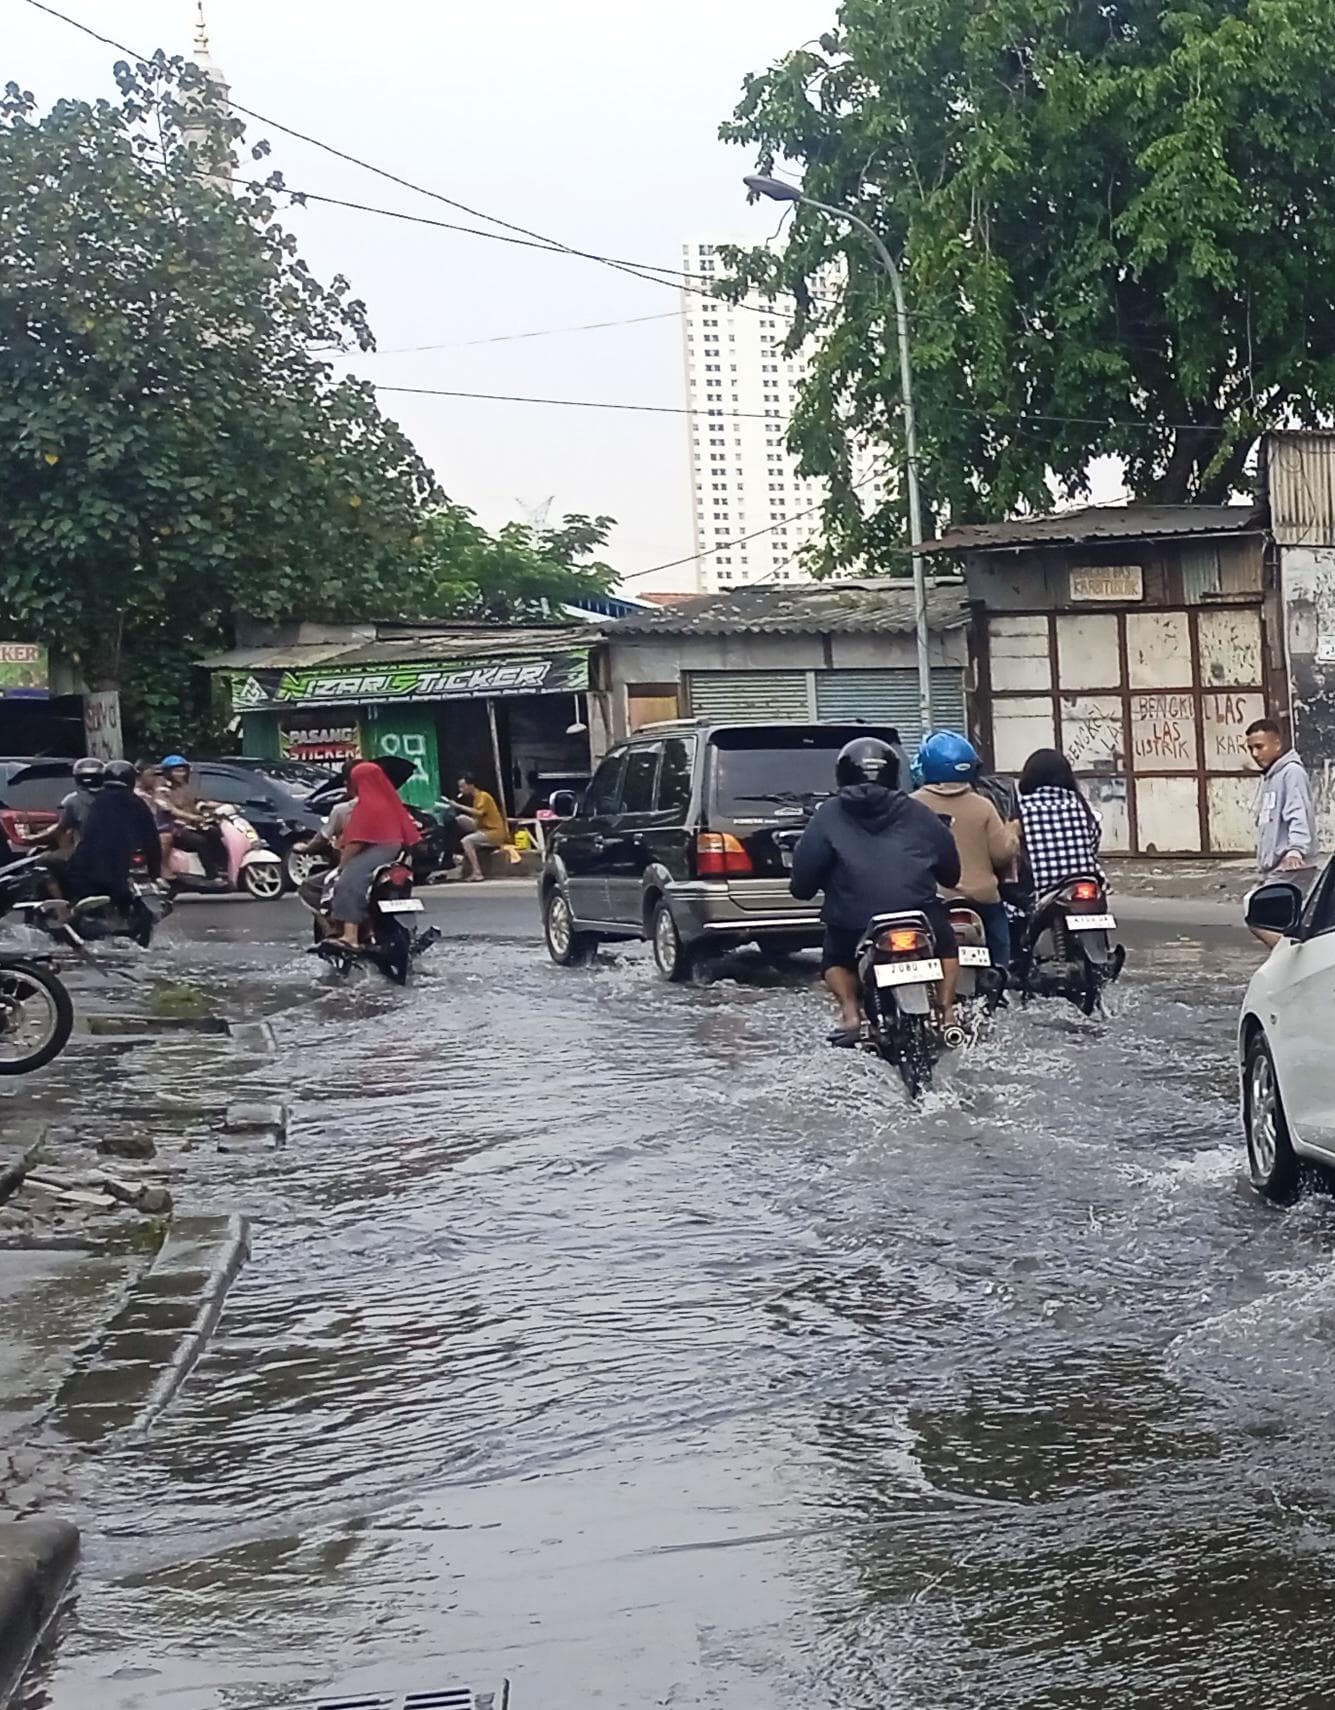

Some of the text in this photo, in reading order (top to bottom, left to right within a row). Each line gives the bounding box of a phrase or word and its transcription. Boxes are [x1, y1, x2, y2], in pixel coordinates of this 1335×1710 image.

[273, 671, 386, 702] NIZAR
[390, 663, 549, 695] STICKER
[1216, 694, 1246, 725] LAS
[290, 727, 352, 745] PASANG
[1153, 721, 1181, 742] LAS
[290, 748, 354, 761] STICKER
[1135, 739, 1189, 759] LISTRIK
